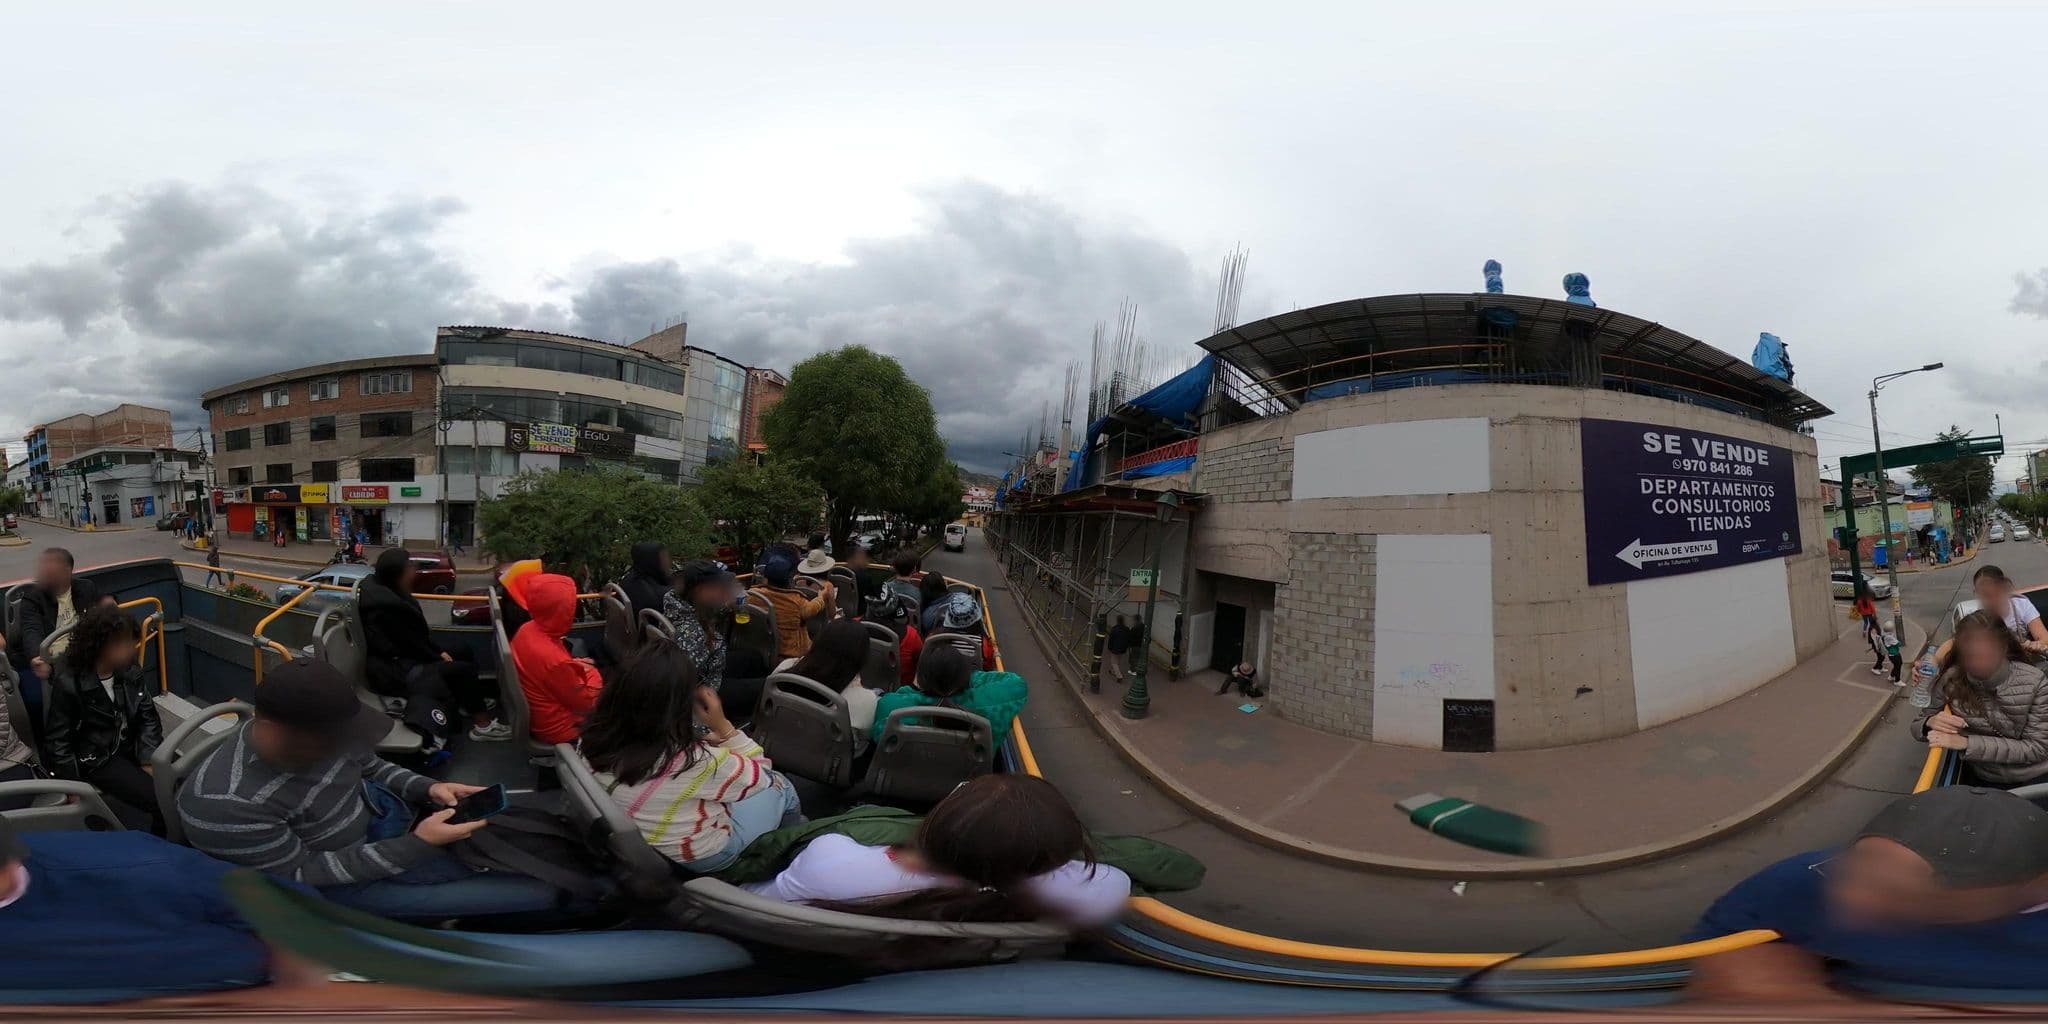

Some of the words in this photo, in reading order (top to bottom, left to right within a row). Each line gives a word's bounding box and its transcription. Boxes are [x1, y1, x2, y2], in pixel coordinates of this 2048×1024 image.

[544, 426, 576, 438] VENDE
[1643, 432, 1682, 454] SE
[1691, 437, 1769, 466] VENDE
[1682, 459, 1707, 473] 970
[1710, 461, 1731, 475] 841
[1733, 463, 1753, 477] 286
[1641, 478, 1775, 497] DEPARTAMENTOS
[1652, 498, 1772, 515] CONSULTORIOS
[1687, 515, 1752, 532] TIENDAS
[1633, 547, 1670, 558] OFICINA
[1671, 546, 1683, 555] DE
[1684, 543, 1713, 553] VENTAS
[1743, 543, 1760, 553] BBVA
